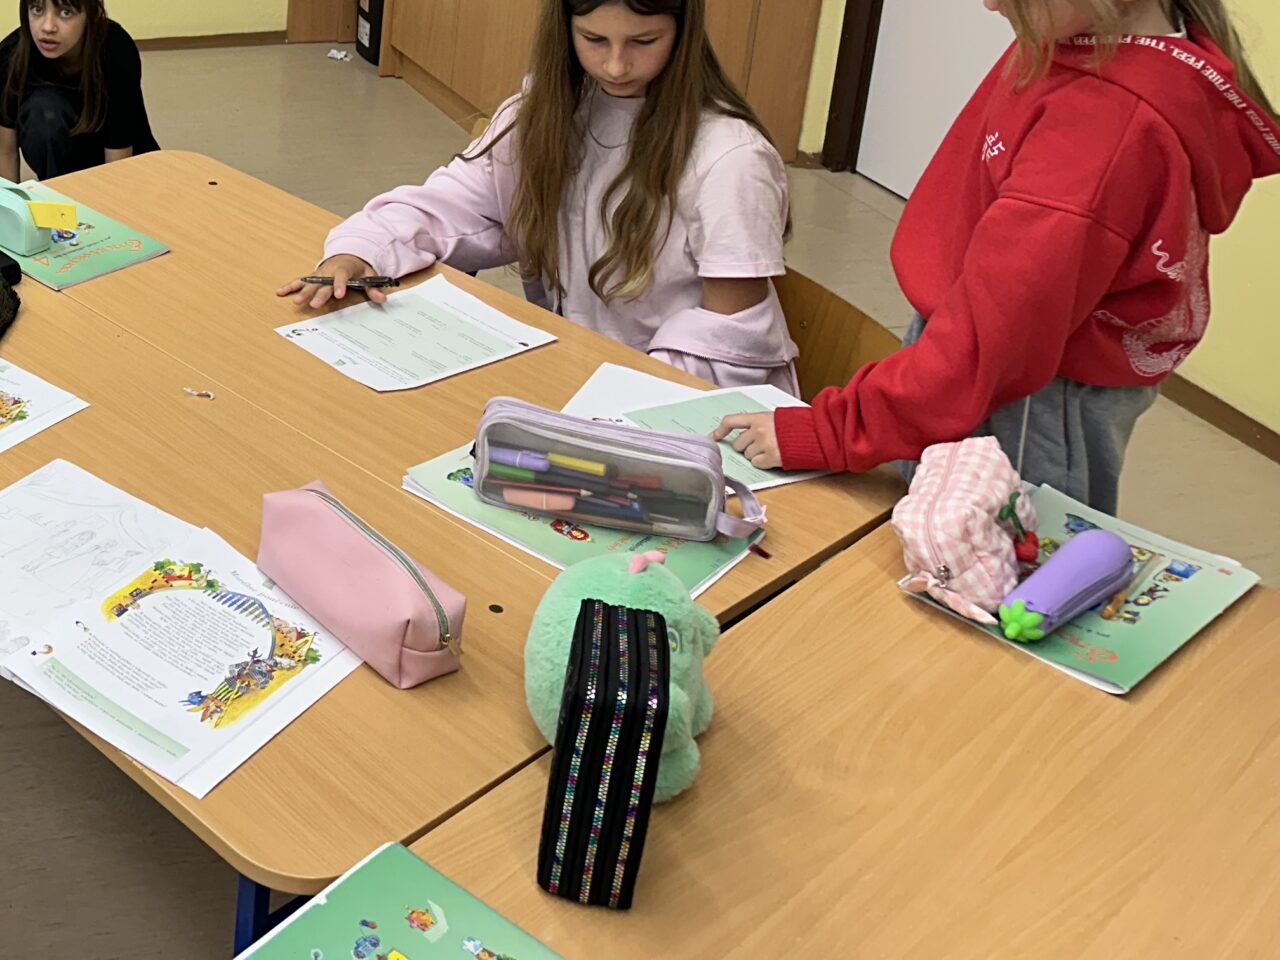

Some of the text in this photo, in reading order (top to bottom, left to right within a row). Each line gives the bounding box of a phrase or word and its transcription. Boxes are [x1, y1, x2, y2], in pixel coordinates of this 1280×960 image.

[1135, 36, 1167, 52] THE
[1169, 44, 1206, 71] FEEL
[1201, 64, 1232, 93] FIRE
[1223, 88, 1249, 110] THE
